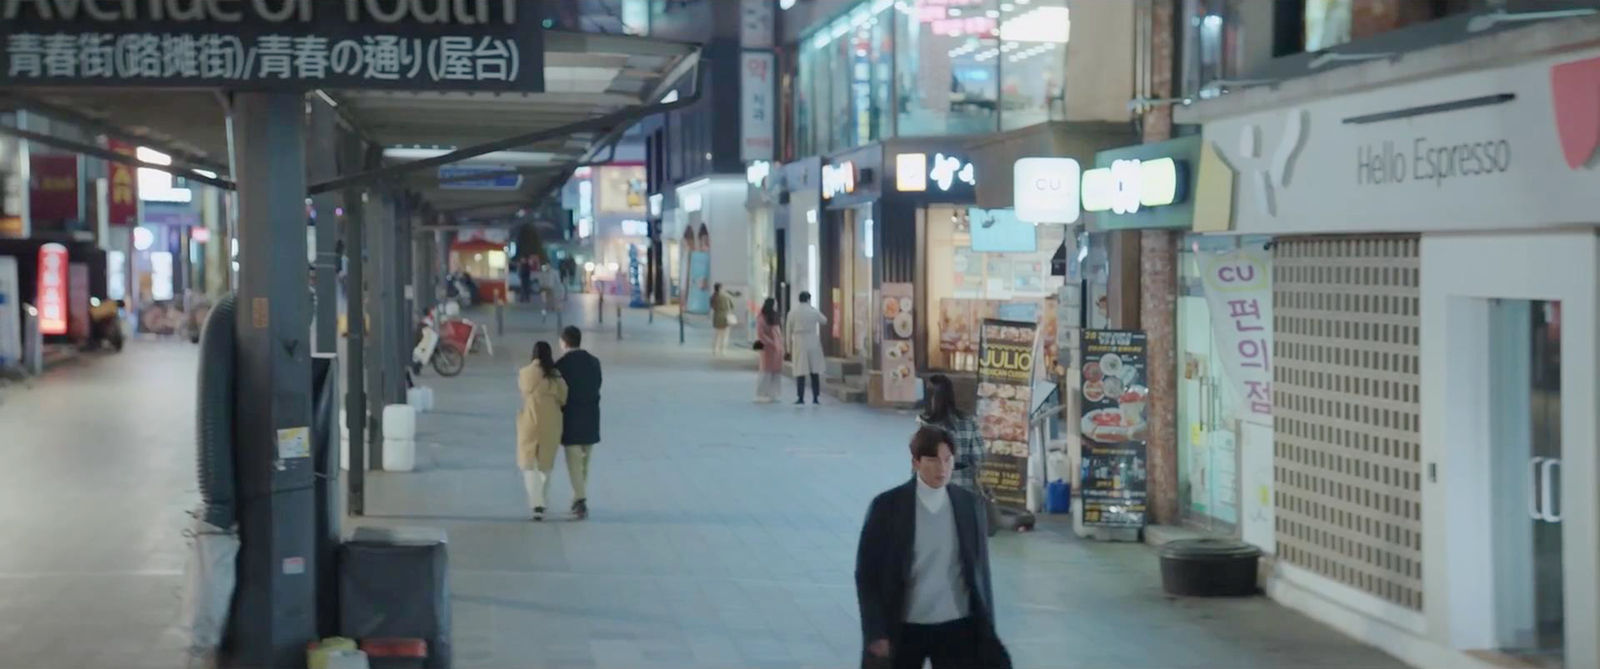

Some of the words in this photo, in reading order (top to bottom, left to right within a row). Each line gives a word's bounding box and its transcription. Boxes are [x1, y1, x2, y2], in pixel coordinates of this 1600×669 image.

[1357, 140, 1406, 185] Hello
[1413, 137, 1512, 188] Espresso
[1035, 178, 1061, 191] CU
[1218, 265, 1254, 282] CU
[980, 350, 1031, 371] JULIO
[1227, 299, 1272, 414] 편의점
